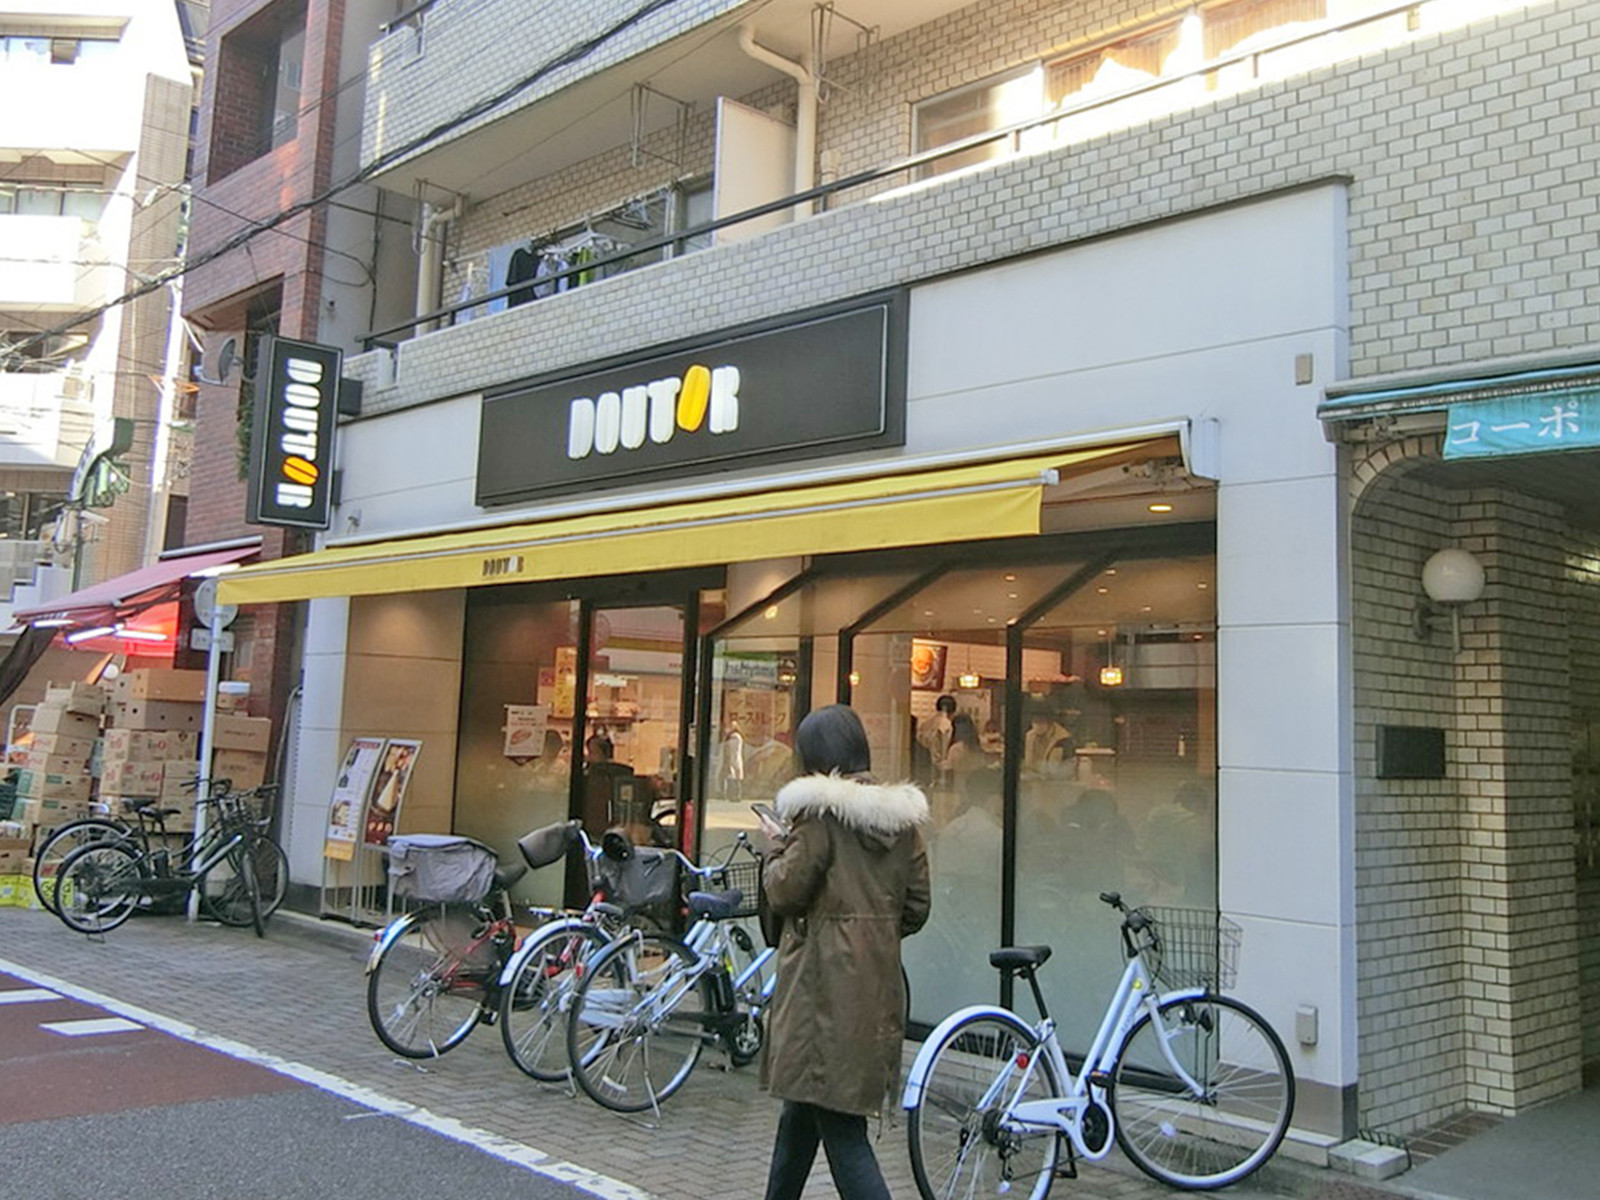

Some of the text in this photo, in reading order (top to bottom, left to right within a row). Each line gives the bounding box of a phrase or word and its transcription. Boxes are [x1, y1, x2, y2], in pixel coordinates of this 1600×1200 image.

[275, 357, 323, 508] DOUTOR
[567, 364, 740, 461] DOUTOR
[1451, 400, 1579, 445] コーポ
